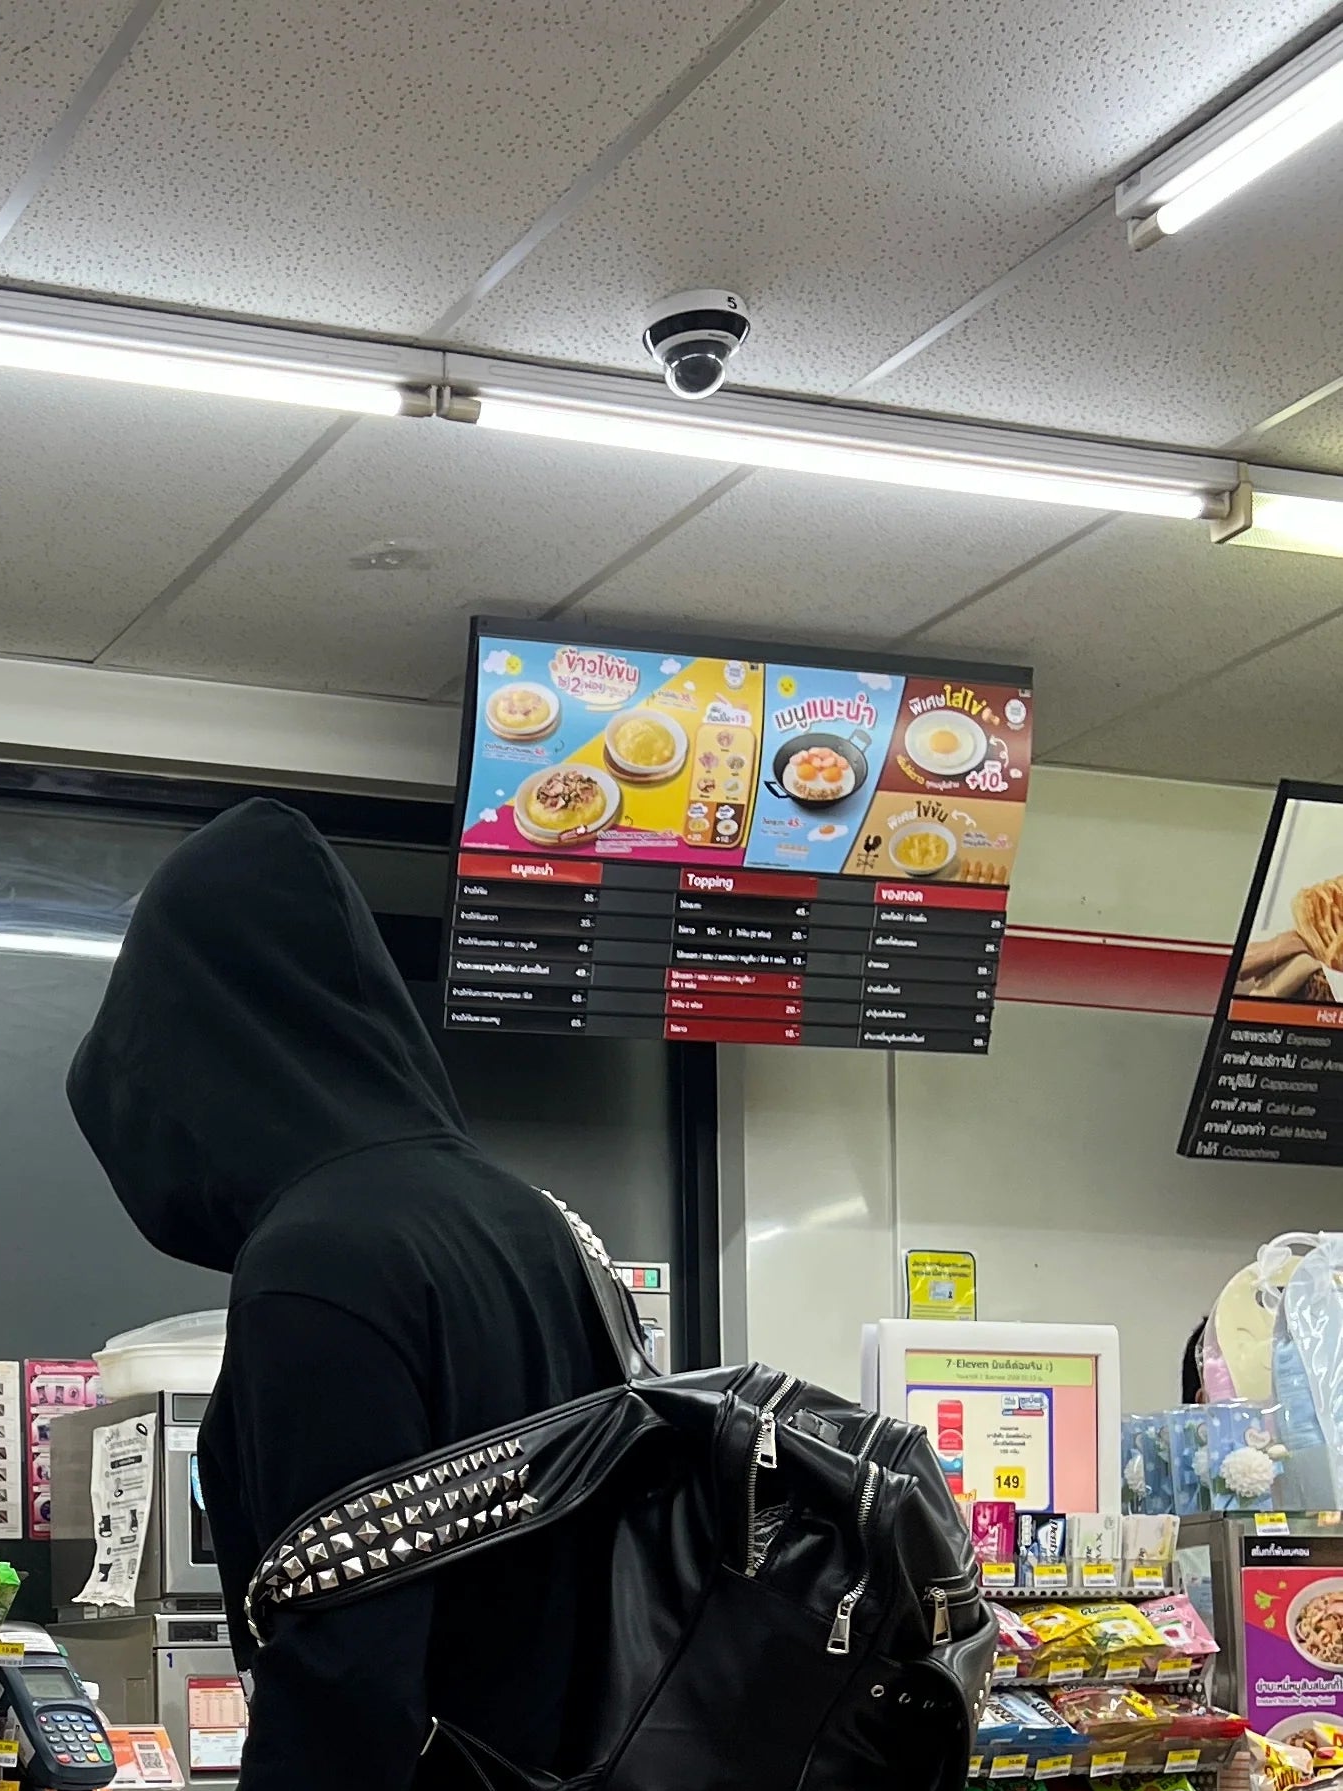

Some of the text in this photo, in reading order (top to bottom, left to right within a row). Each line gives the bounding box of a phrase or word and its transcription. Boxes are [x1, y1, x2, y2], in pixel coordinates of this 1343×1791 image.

[727, 296, 737, 309] 5
[774, 694, 875, 729] เมนูแนะนำ
[687, 873, 734, 891] Topping
[882, 889, 923, 902] ของทอด
[1316, 1010, 1337, 1023] Hot
[946, 1359, 989, 1369] 7-Eleven
